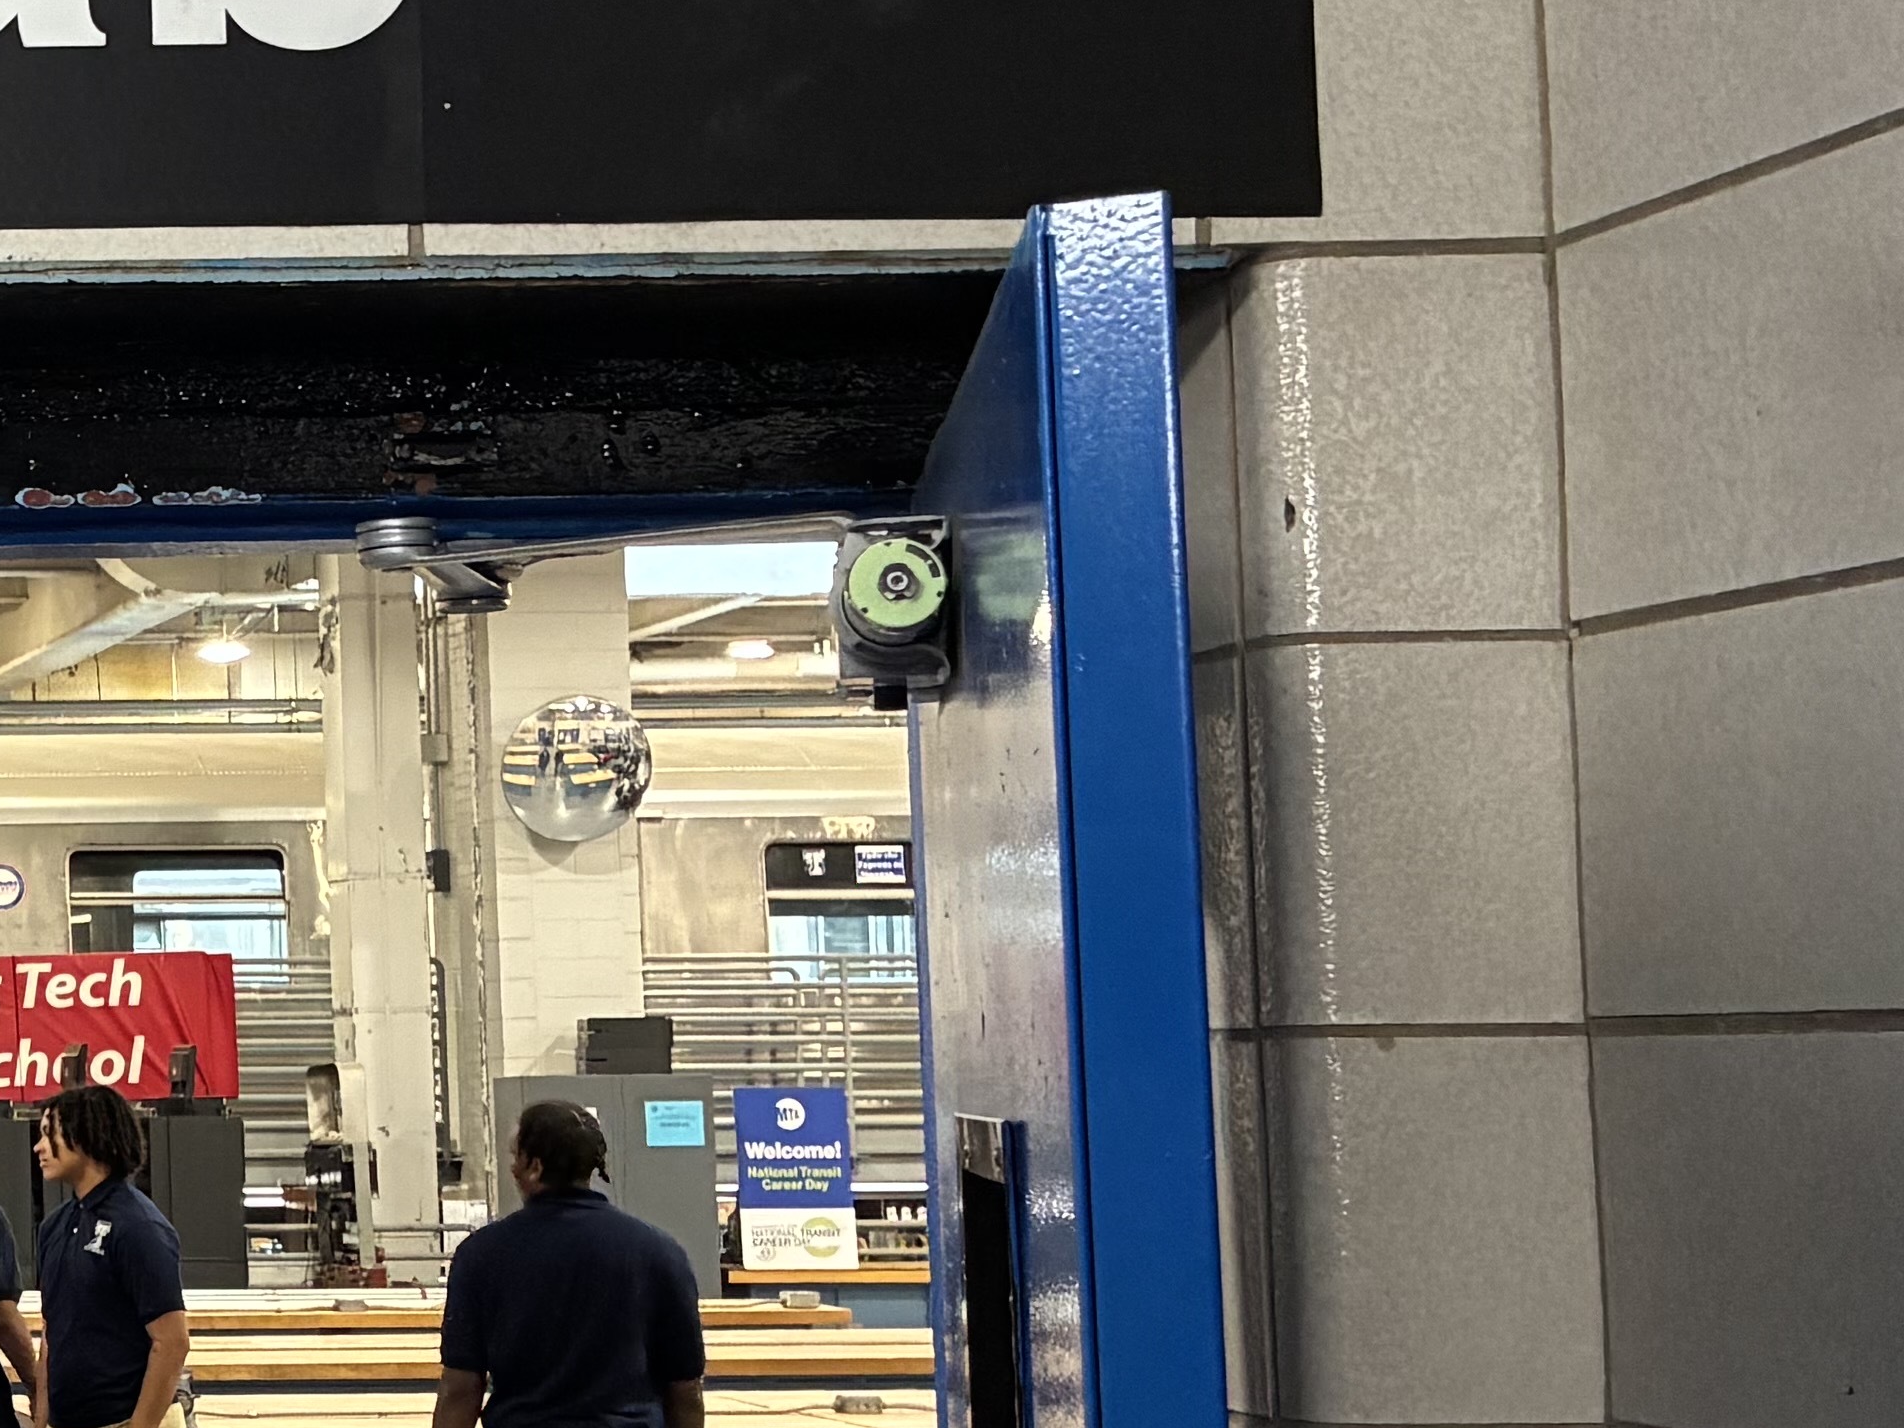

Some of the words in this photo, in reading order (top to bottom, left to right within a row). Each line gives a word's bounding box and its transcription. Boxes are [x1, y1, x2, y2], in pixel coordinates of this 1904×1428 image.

[15, 958, 143, 1010] Tech
[744, 1140, 842, 1160] Welcome!
[748, 1166, 798, 1178] National
[799, 1165, 842, 1178] Transit
[762, 1178, 803, 1191] Career
[805, 1178, 829, 1192] Day
